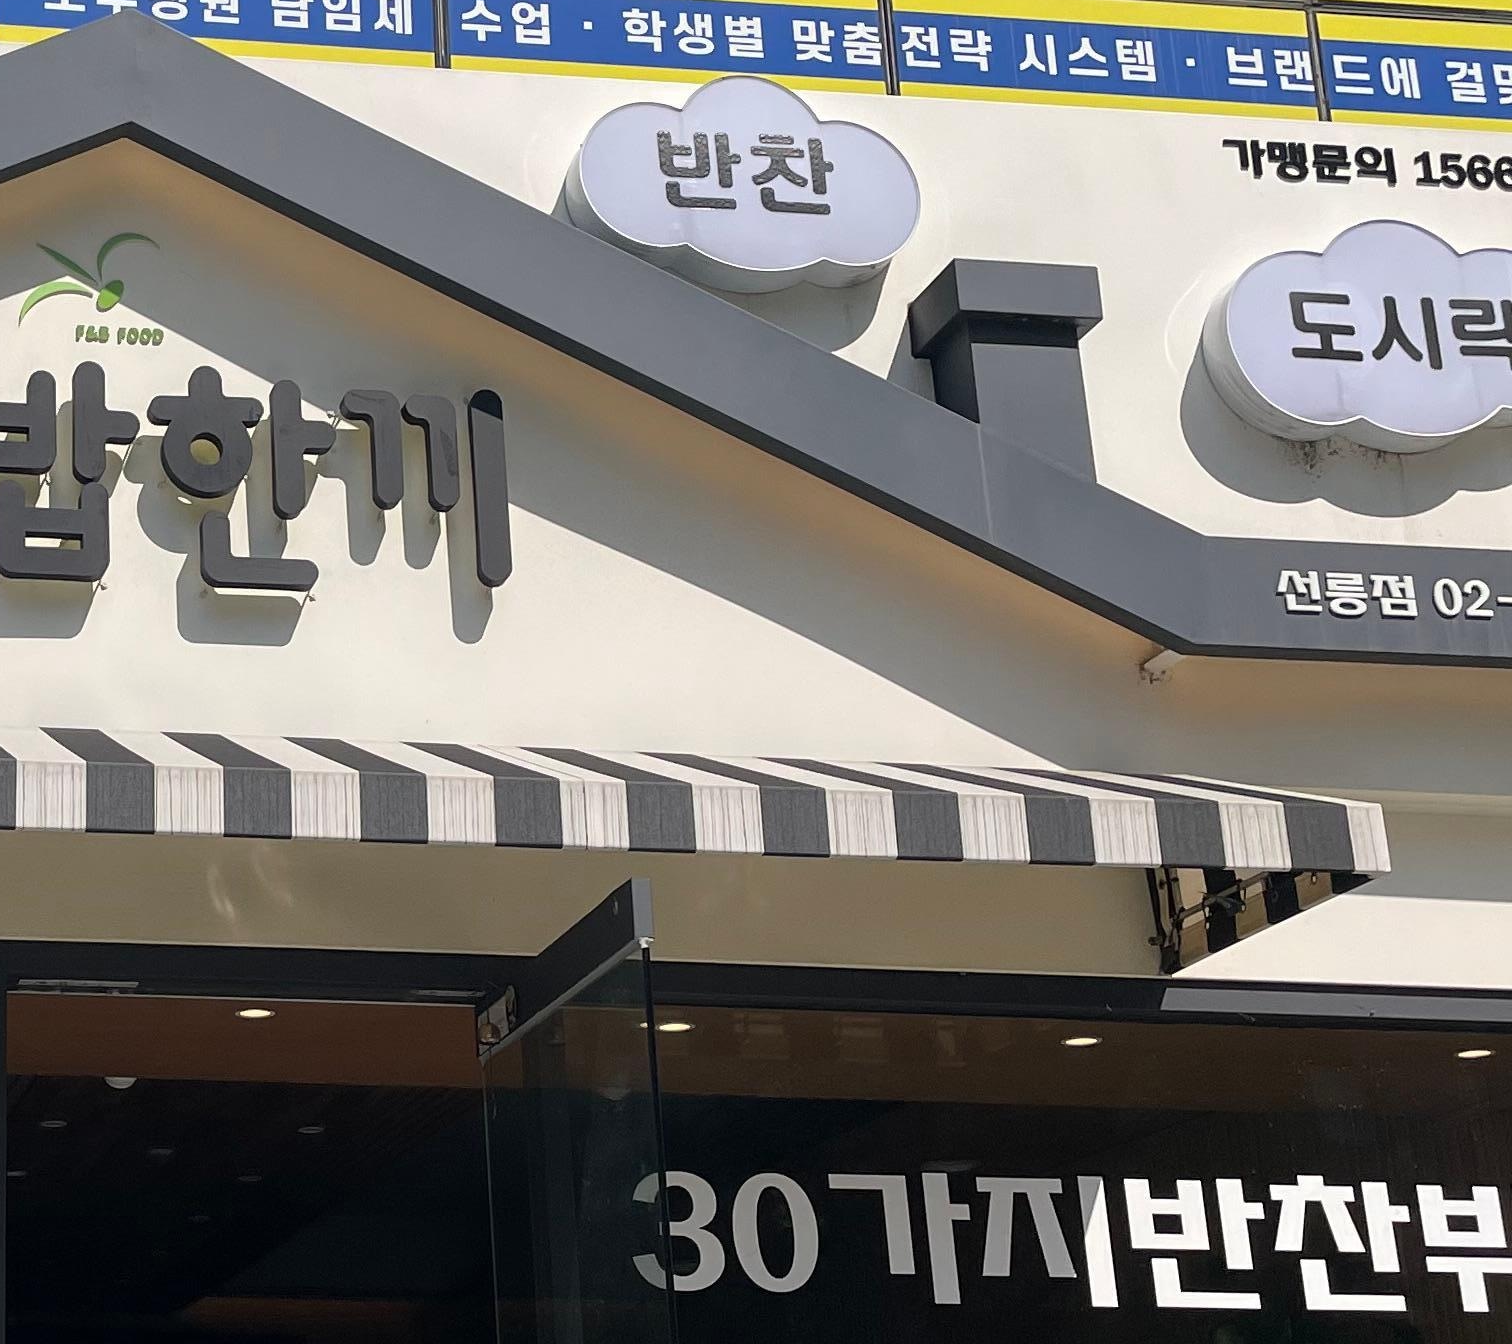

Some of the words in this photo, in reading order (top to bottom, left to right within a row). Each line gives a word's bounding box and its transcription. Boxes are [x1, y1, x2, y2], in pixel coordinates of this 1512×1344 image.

[461, 0, 551, 45] 수업
[622, 7, 765, 59] 학생별
[1019, 33, 1157, 82] 시스템
[1227, 47, 1421, 99] 브랜드에
[656, 130, 834, 215] 반찬
[1223, 139, 1397, 187] 가맹문의
[75, 325, 110, 343] F&B
[117, 327, 164, 346] FOOD
[1289, 292, 1512, 370] 도시락
[1276, 570, 1418, 620] 선릉점
